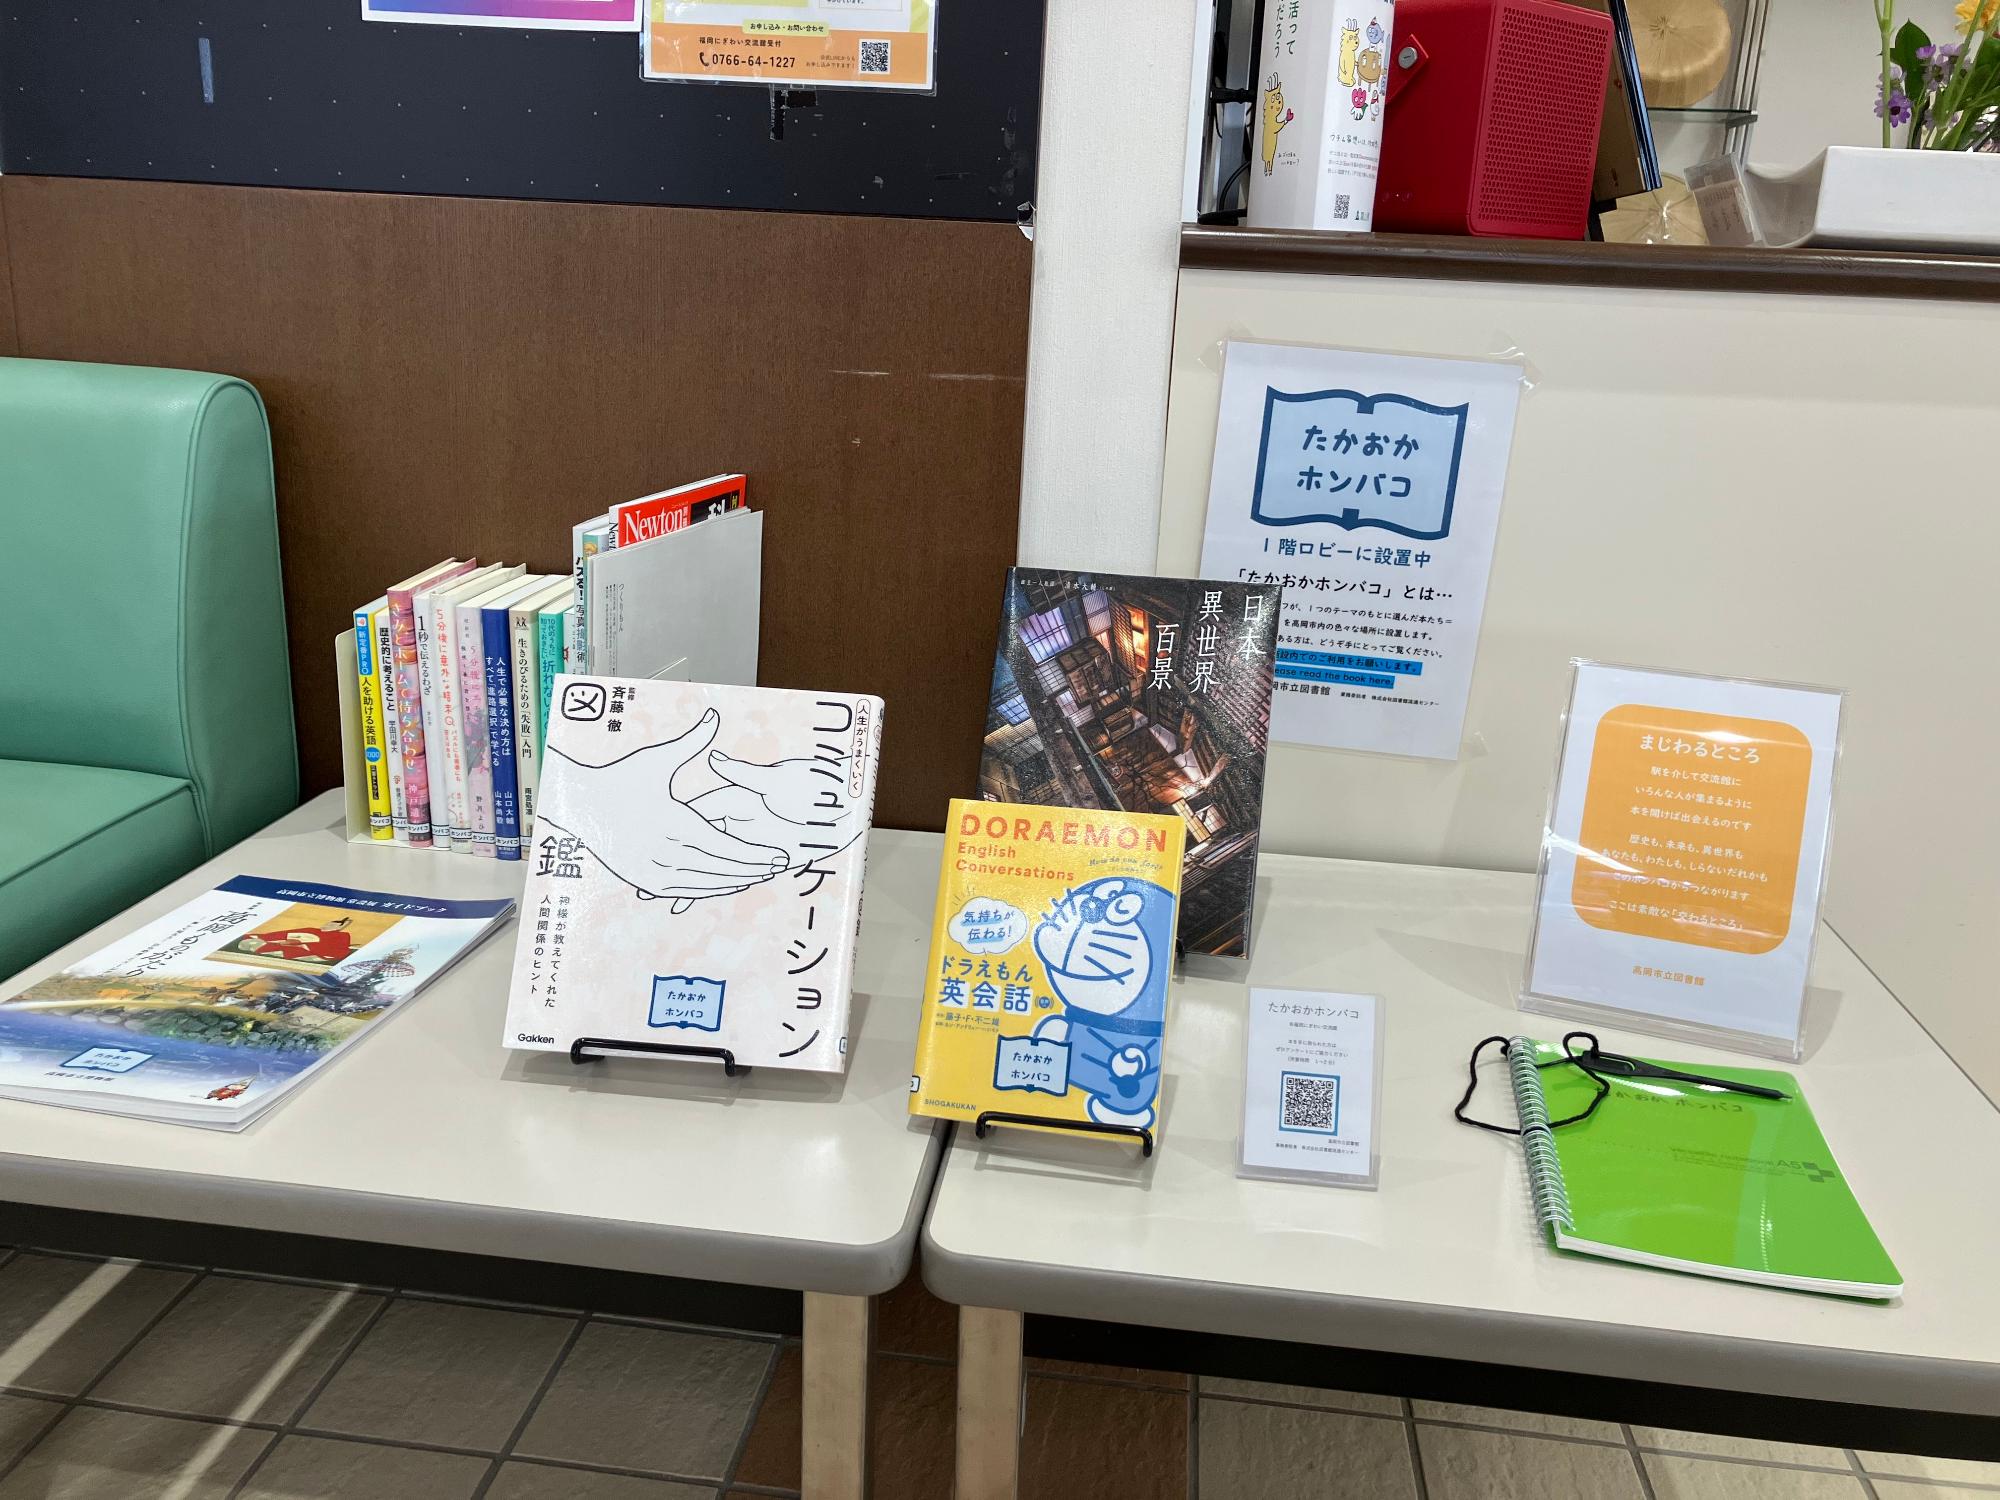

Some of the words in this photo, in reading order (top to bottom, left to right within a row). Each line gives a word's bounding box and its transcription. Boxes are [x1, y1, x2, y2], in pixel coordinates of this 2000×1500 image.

[712, 53, 796, 68] 0766-64-1227
[1302, 425, 1419, 460] たかおか
[1296, 465, 1411, 498] ホンバコ
[624, 506, 684, 545] Newton
[1188, 590, 1224, 694] 異世界
[1238, 594, 1268, 661] 日本
[379, 627, 396, 712] 歴史的に考えること
[1147, 623, 1180, 690] 百景
[1300, 668, 1322, 679] read
[1324, 670, 1341, 681] the
[1343, 672, 1366, 684] book
[361, 677, 377, 745] 人を助ける英語
[496, 656, 512, 756] 人生で必要な決め方は
[517, 638, 533, 759] 生きのびるための「失敗」入門
[852, 704, 869, 791] 人生がうまくいく
[1639, 733, 1761, 764] まじわるところ
[959, 813, 1167, 852] DORAEMON
[1630, 805, 1752, 832] 本を開けば出会えるのです
[957, 841, 1016, 859] English
[779, 700, 853, 1058] コミュニケーション
[956, 859, 1075, 881] Conversations
[963, 910, 1014, 924] 気持ちが
[530, 893, 552, 995] 人間関係のヒント
[544, 895, 571, 1008] 神様が教えてくれた
[942, 955, 1033, 983] ドラえもん
[1632, 965, 1705, 987] 高岡市立図書館
[667, 990, 707, 1003] たかおか
[938, 976, 1031, 1012] 英会話
[664, 1007, 704, 1019] ホンバコ
[1268, 1001, 1360, 1020] たかおかホンバコ
[517, 1033, 555, 1045] Gakken
[1012, 1051, 1053, 1065] たかおか
[1010, 1069, 1051, 1082] ホンバコ
[924, 1098, 977, 1111] SHOGAKUKAN
